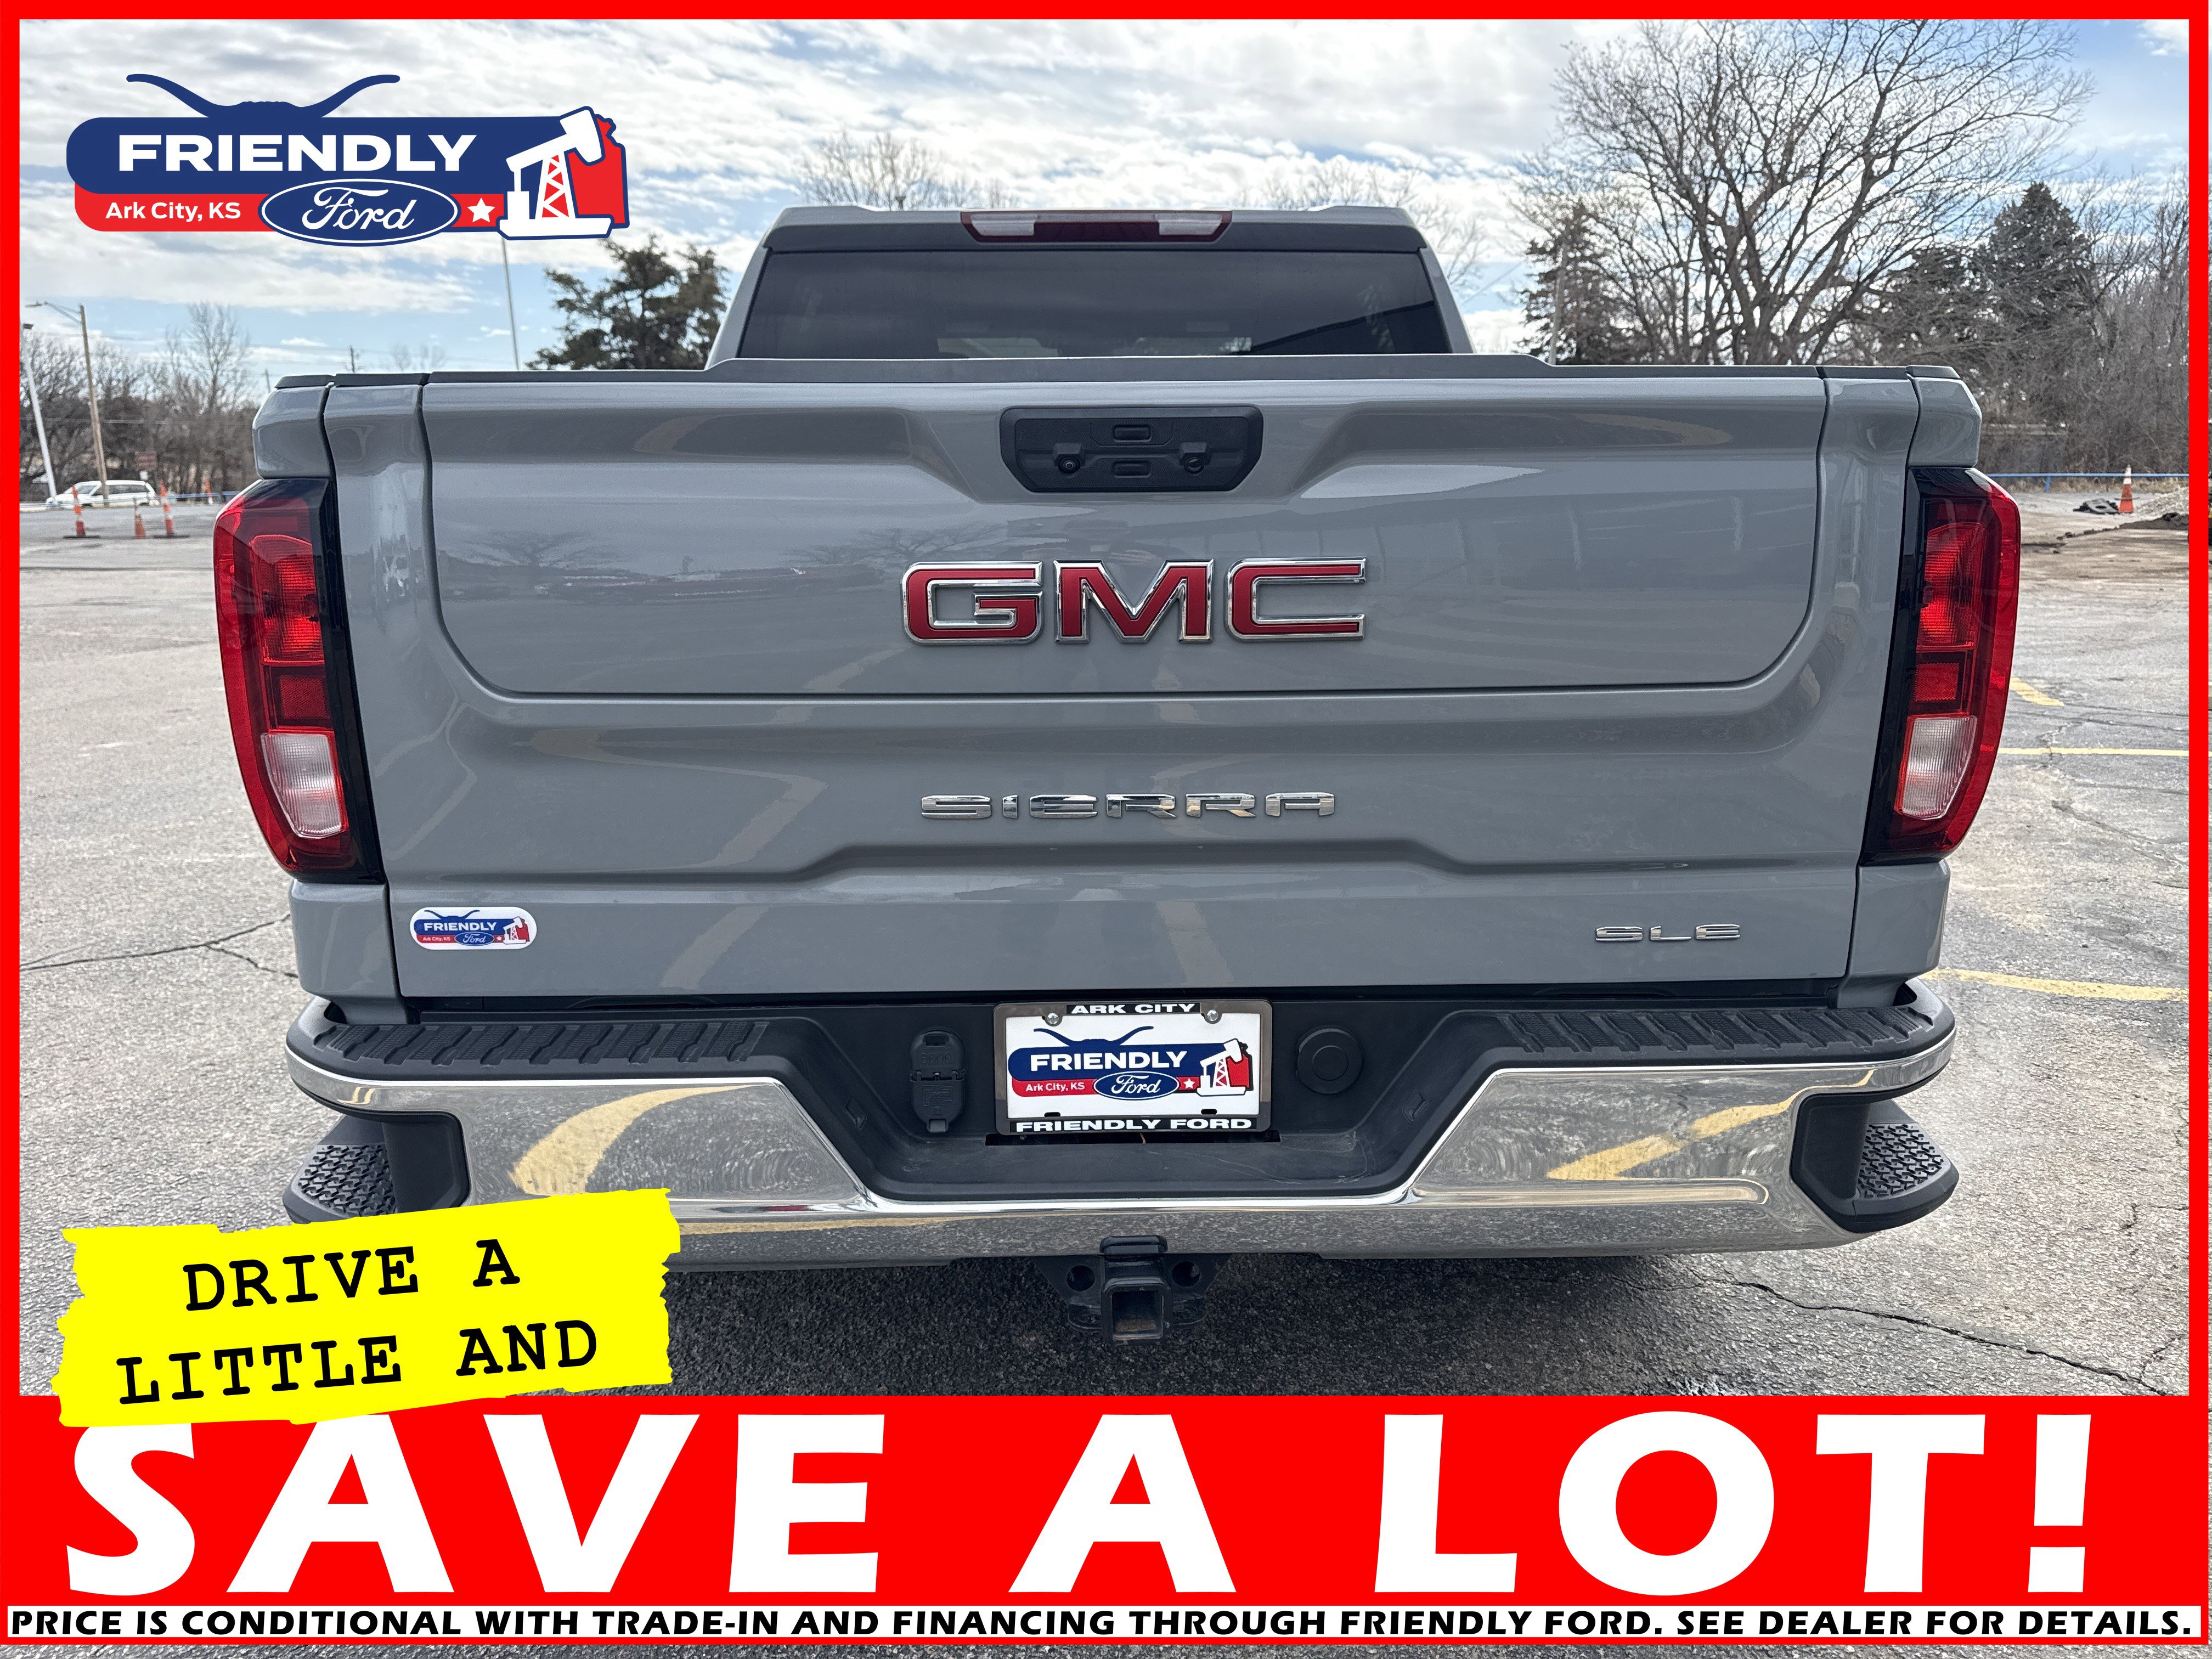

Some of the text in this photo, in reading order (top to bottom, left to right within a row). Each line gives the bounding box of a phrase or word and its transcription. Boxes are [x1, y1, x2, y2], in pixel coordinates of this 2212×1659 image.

[901, 557, 1367, 644] GMC
[921, 792, 1335, 819] SIERRA
[424, 922, 497, 932] FRIENDLY
[1595, 923, 1741, 941] SLE
[462, 933, 487, 943] Ford
[1071, 1003, 1196, 1014] ARK CITY
[1030, 1051, 1188, 1071] FRIENDLY
[1025, 1082, 1085, 1092] Ark City, KS
[1111, 1075, 1162, 1094] Ford
[1016, 1119, 1252, 1132] FRIENDLY FORD
